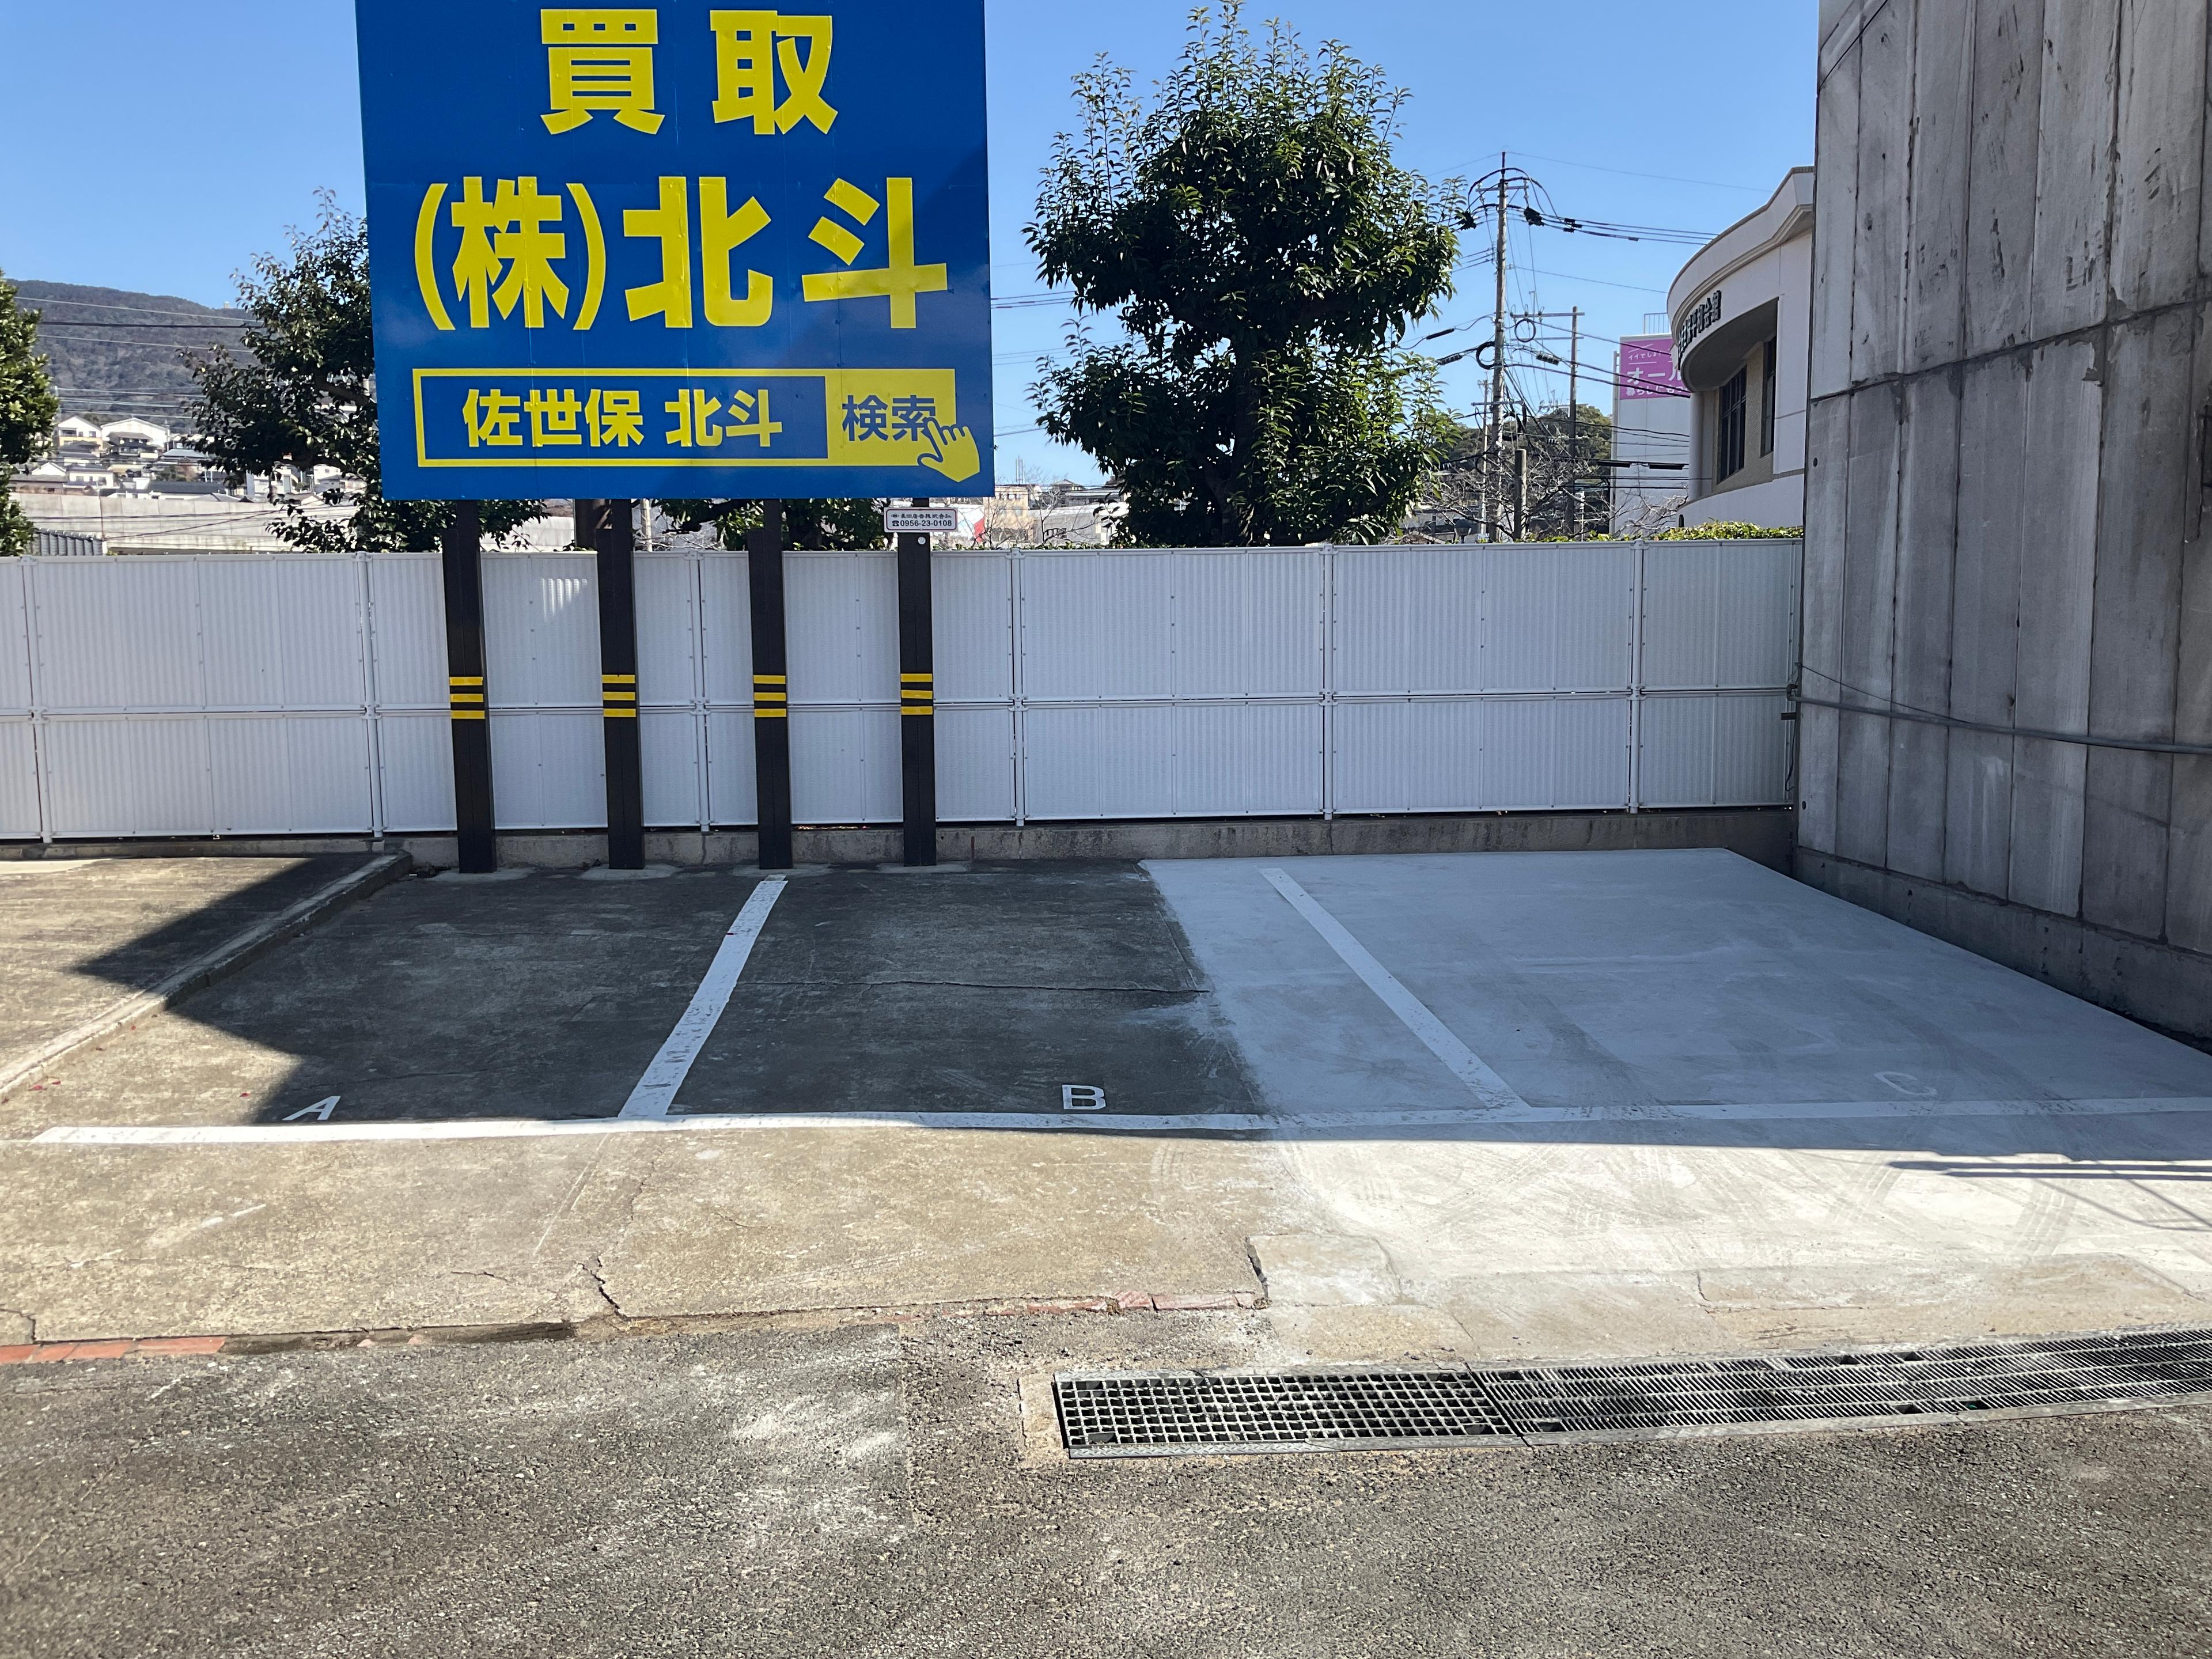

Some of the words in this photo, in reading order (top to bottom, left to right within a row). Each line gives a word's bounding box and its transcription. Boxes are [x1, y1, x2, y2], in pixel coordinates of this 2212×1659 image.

[539, 8, 839, 135] 買取
[414, 176, 948, 331] (株)北斗
[462, 388, 643, 448] 佐世保
[665, 389, 782, 448] 北斗
[842, 395, 936, 442] 検索
[1062, 1084, 1106, 1109] B
[1873, 1071, 1937, 1095] C
[282, 1096, 341, 1120] A
